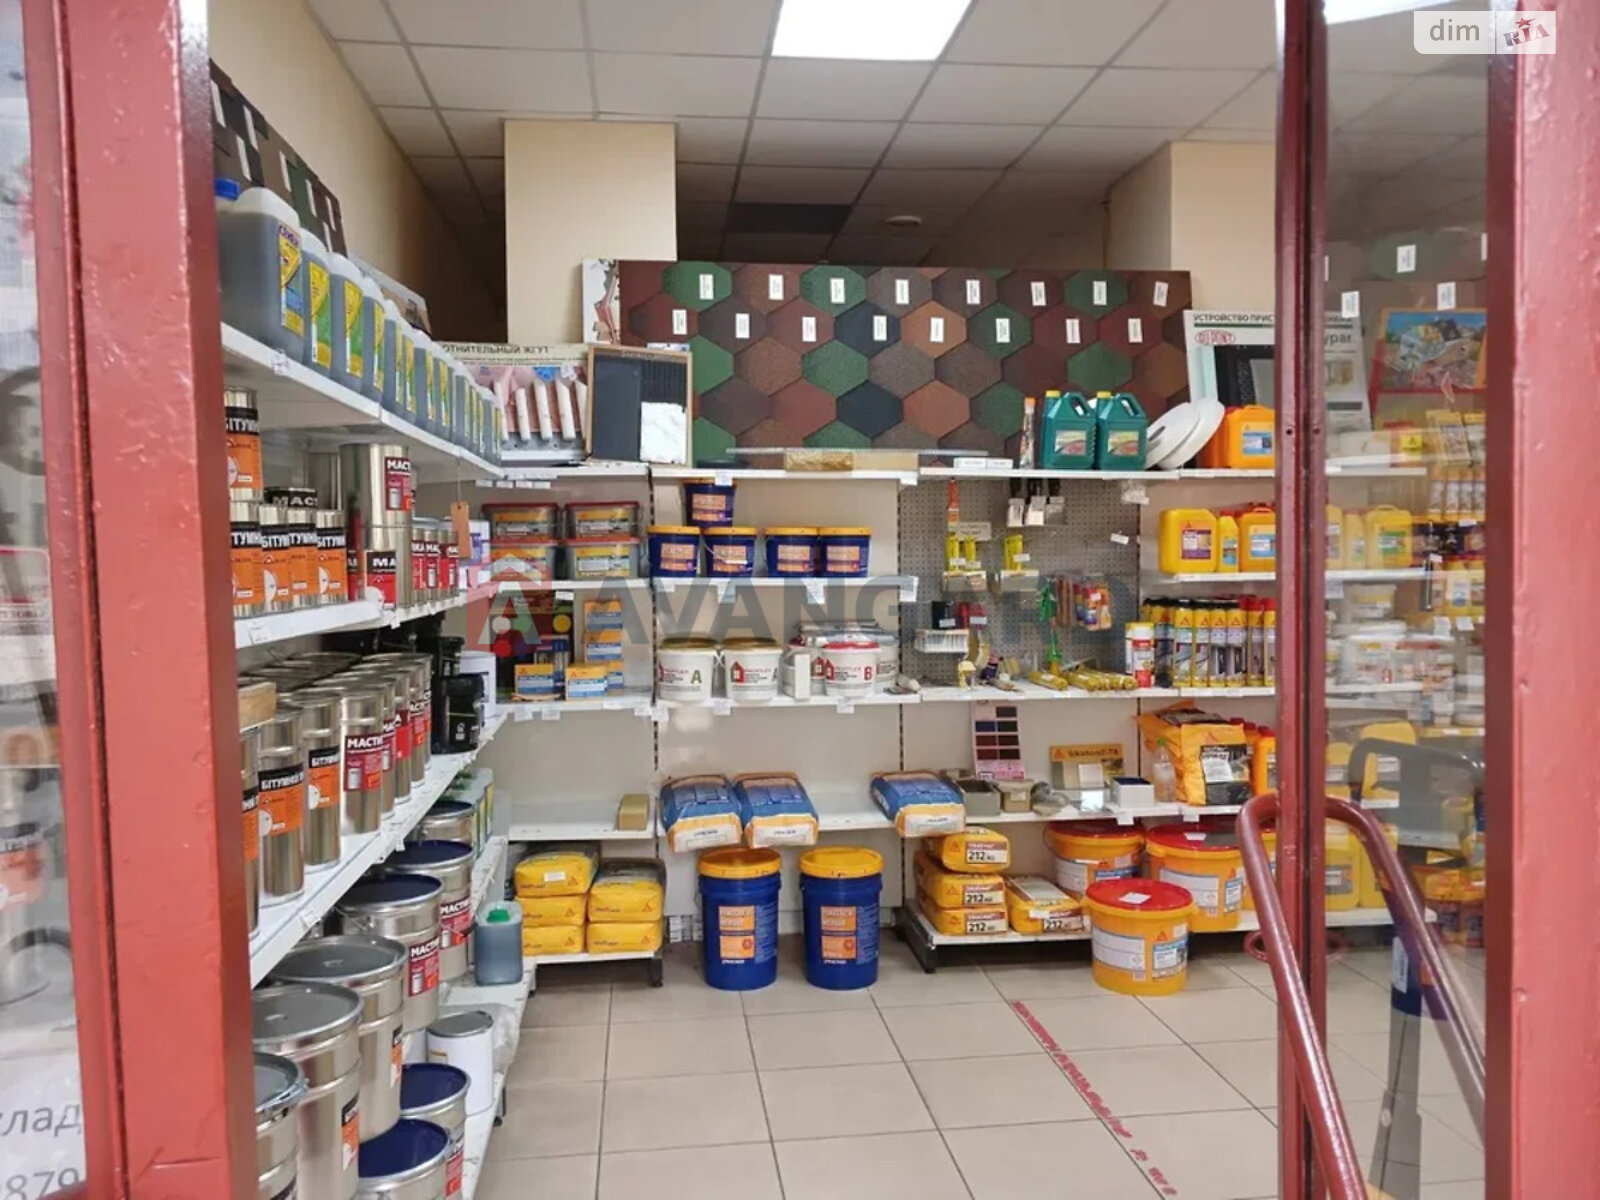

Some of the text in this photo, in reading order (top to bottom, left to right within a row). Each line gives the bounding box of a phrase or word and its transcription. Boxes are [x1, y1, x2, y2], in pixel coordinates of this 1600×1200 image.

[968, 851, 985, 861] 212
[966, 894, 984, 904] 212
[968, 922, 987, 932] 212
